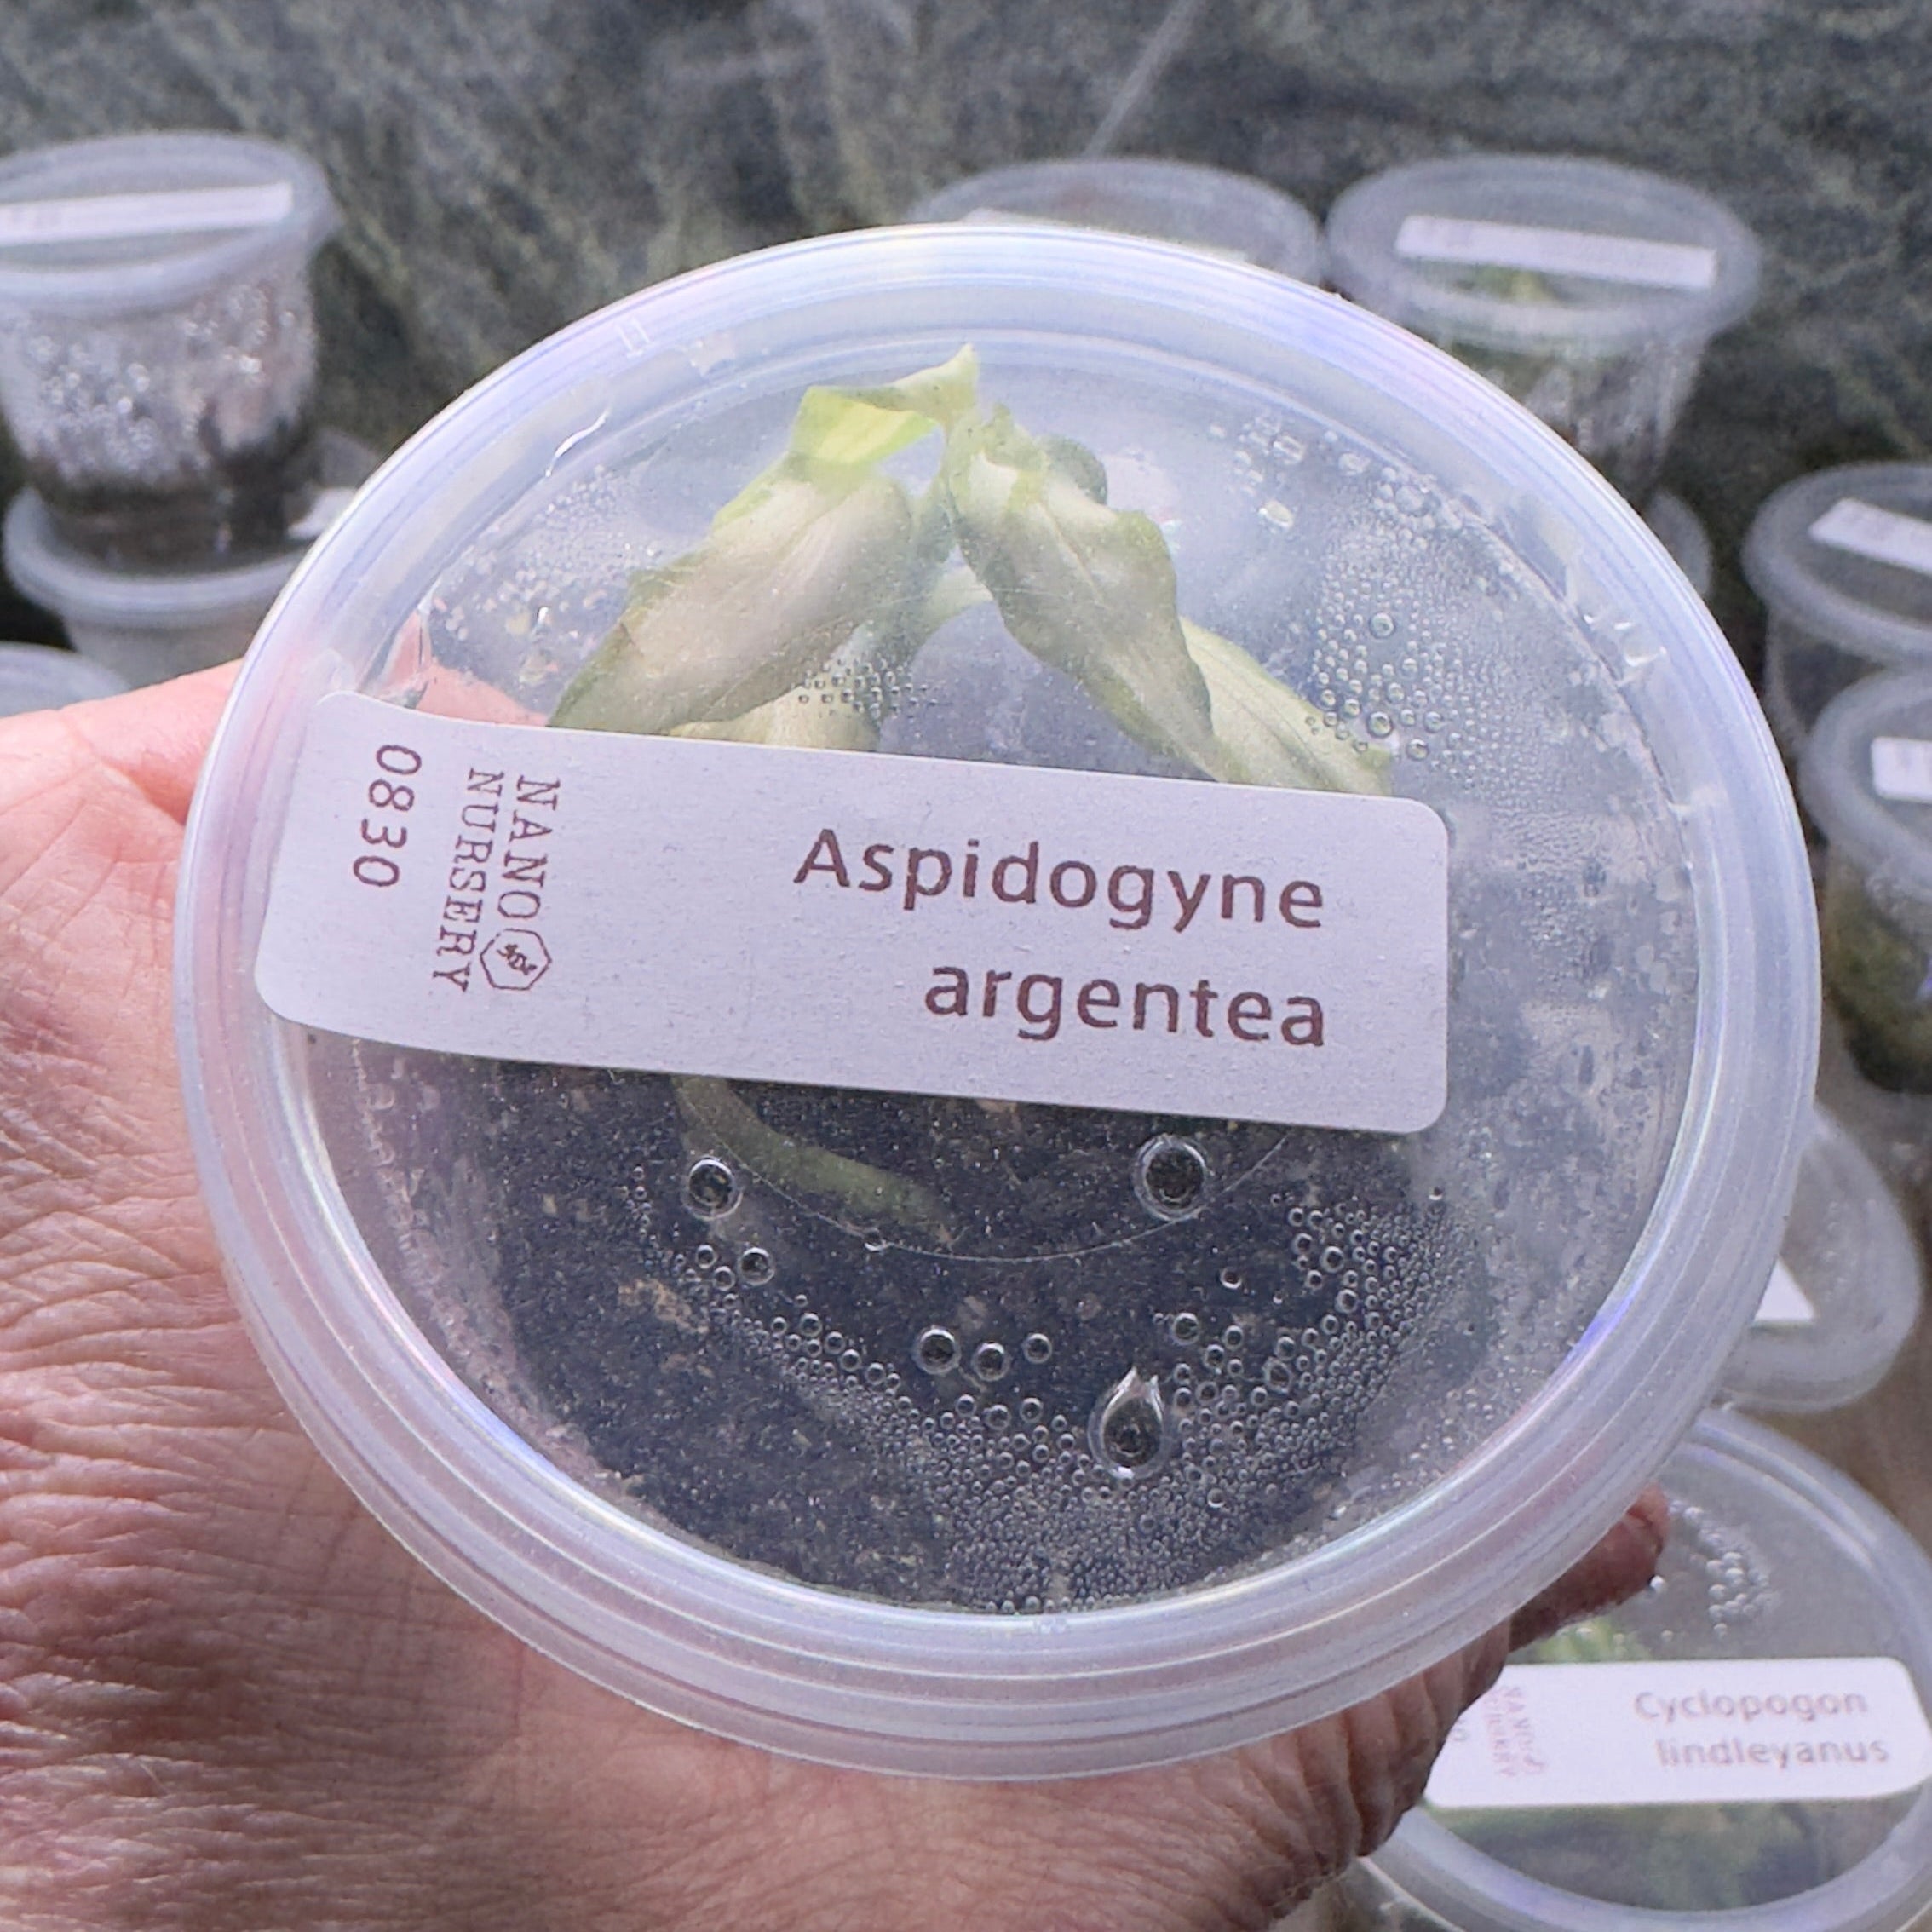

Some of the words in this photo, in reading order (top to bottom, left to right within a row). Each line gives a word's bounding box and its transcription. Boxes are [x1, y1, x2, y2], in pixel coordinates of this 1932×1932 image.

[353, 745, 423, 888] 0830
[497, 774, 561, 919] NANO
[433, 768, 504, 992] NURSERY
[793, 828, 1324, 934] Aspidogyne
[924, 965, 1325, 1047] argentea
[1634, 1688, 1869, 1724] Cyclopogon
[1655, 1736, 1890, 1769] lindleyanus
